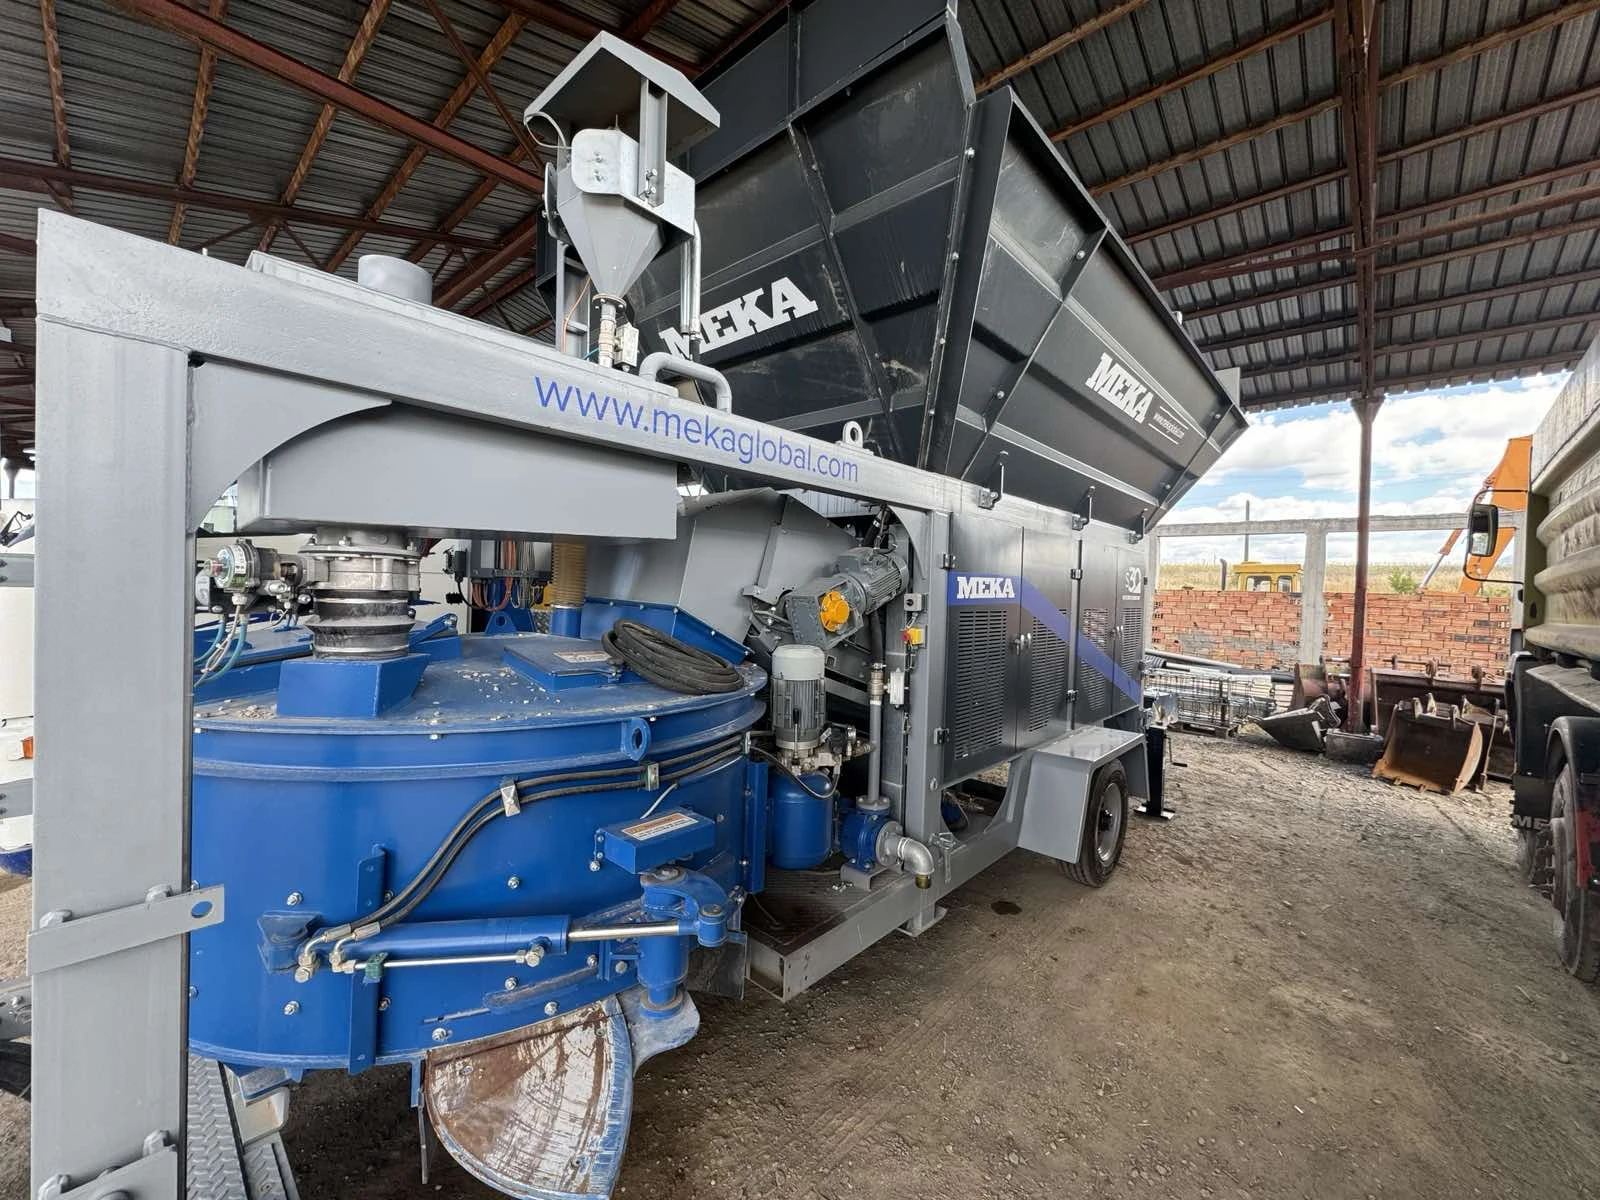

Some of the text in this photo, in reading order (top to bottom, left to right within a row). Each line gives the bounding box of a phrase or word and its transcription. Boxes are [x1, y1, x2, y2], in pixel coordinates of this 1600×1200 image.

[1085, 352, 1154, 424] MEKA
[534, 376, 858, 483] www.mekaglobal.com
[957, 577, 1015, 599] MEKA
